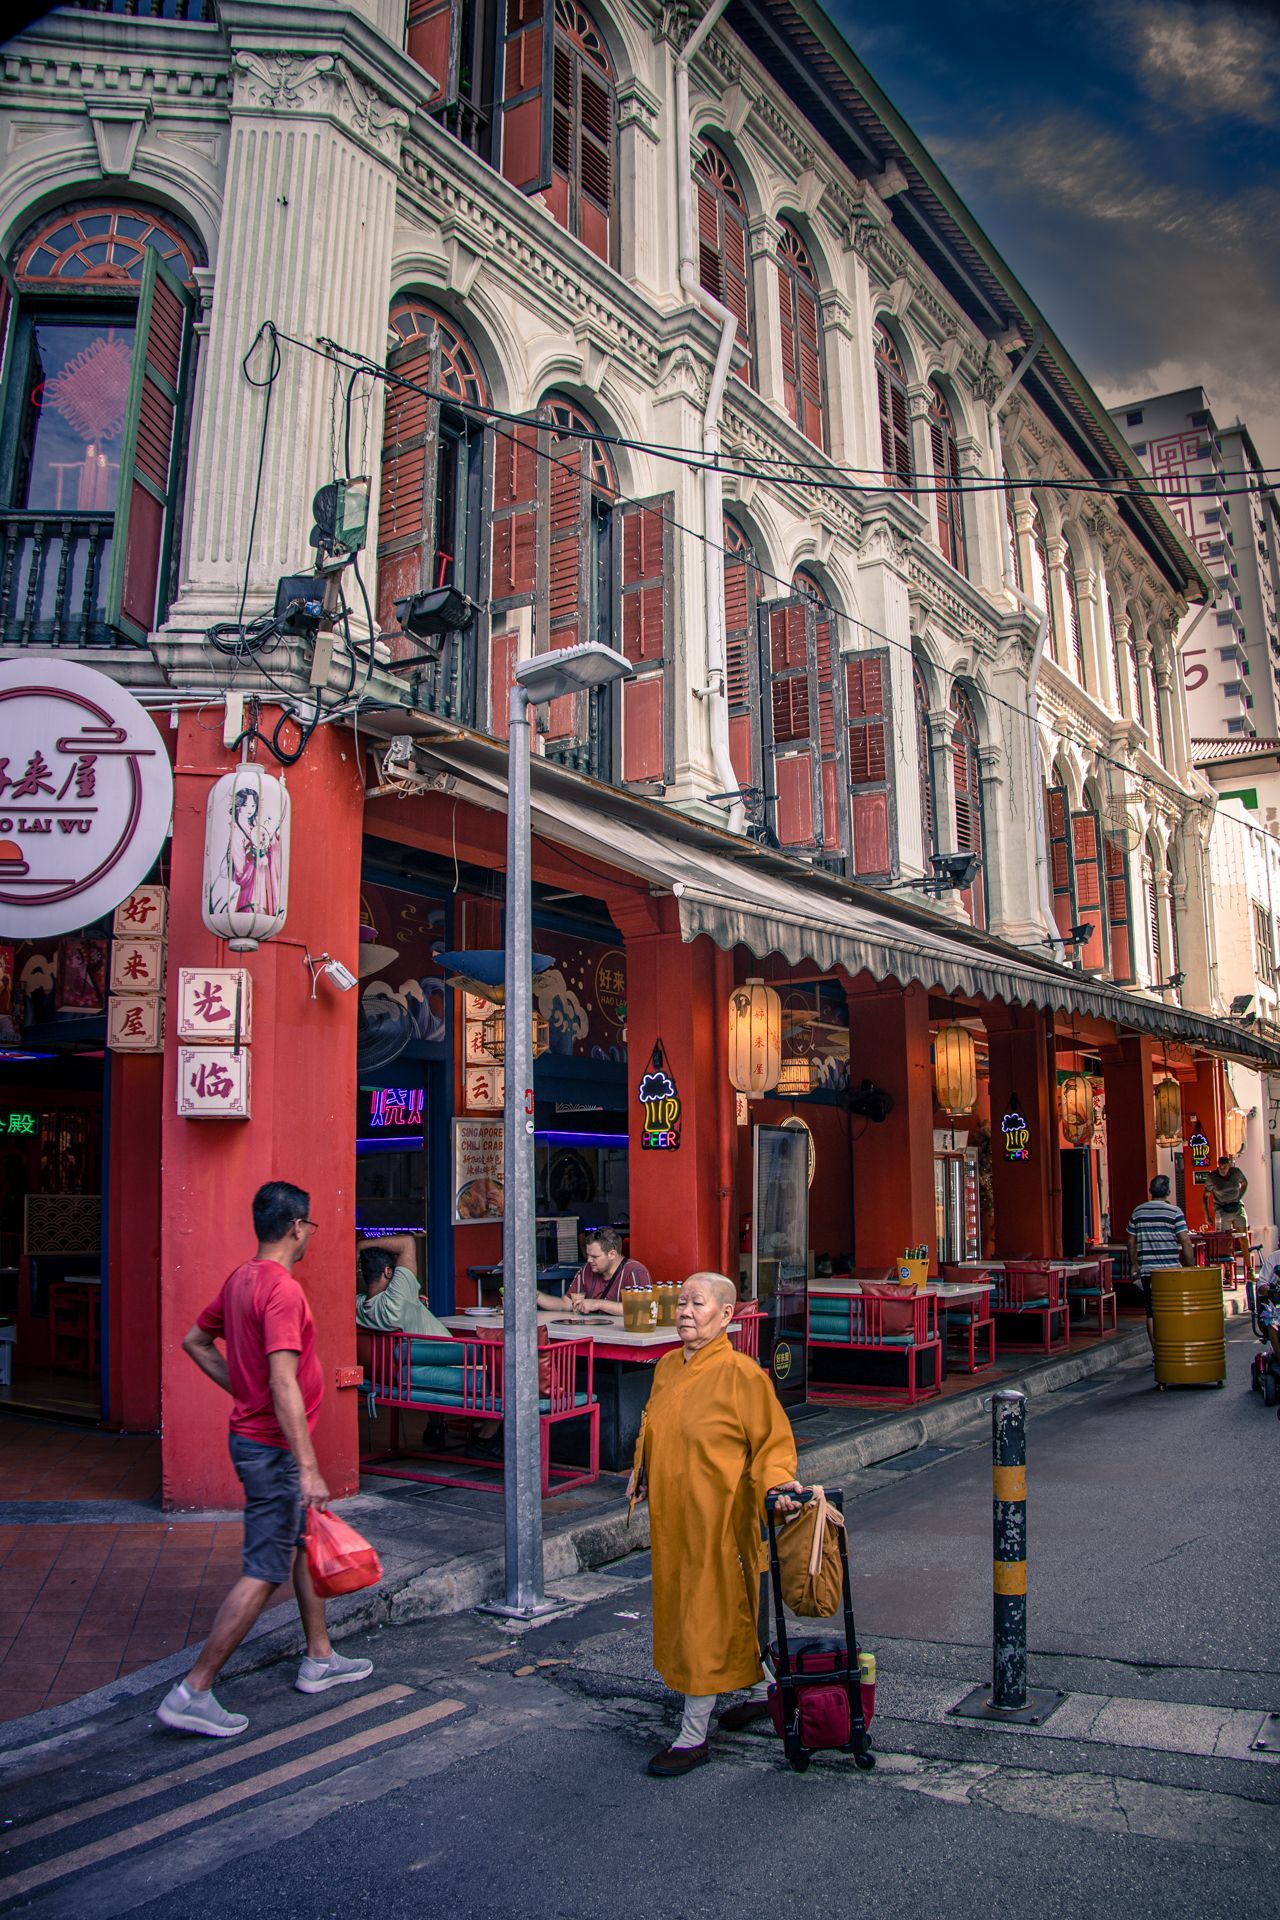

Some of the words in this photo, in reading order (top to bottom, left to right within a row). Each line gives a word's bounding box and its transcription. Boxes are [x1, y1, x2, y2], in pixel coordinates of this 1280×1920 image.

[18, 818, 52, 833] LAI
[57, 818, 92, 834] WU
[0, 1113, 35, 1134] 殿
[461, 1127, 504, 1137] SINGAPORE
[483, 1141, 504, 1150] CRAB
